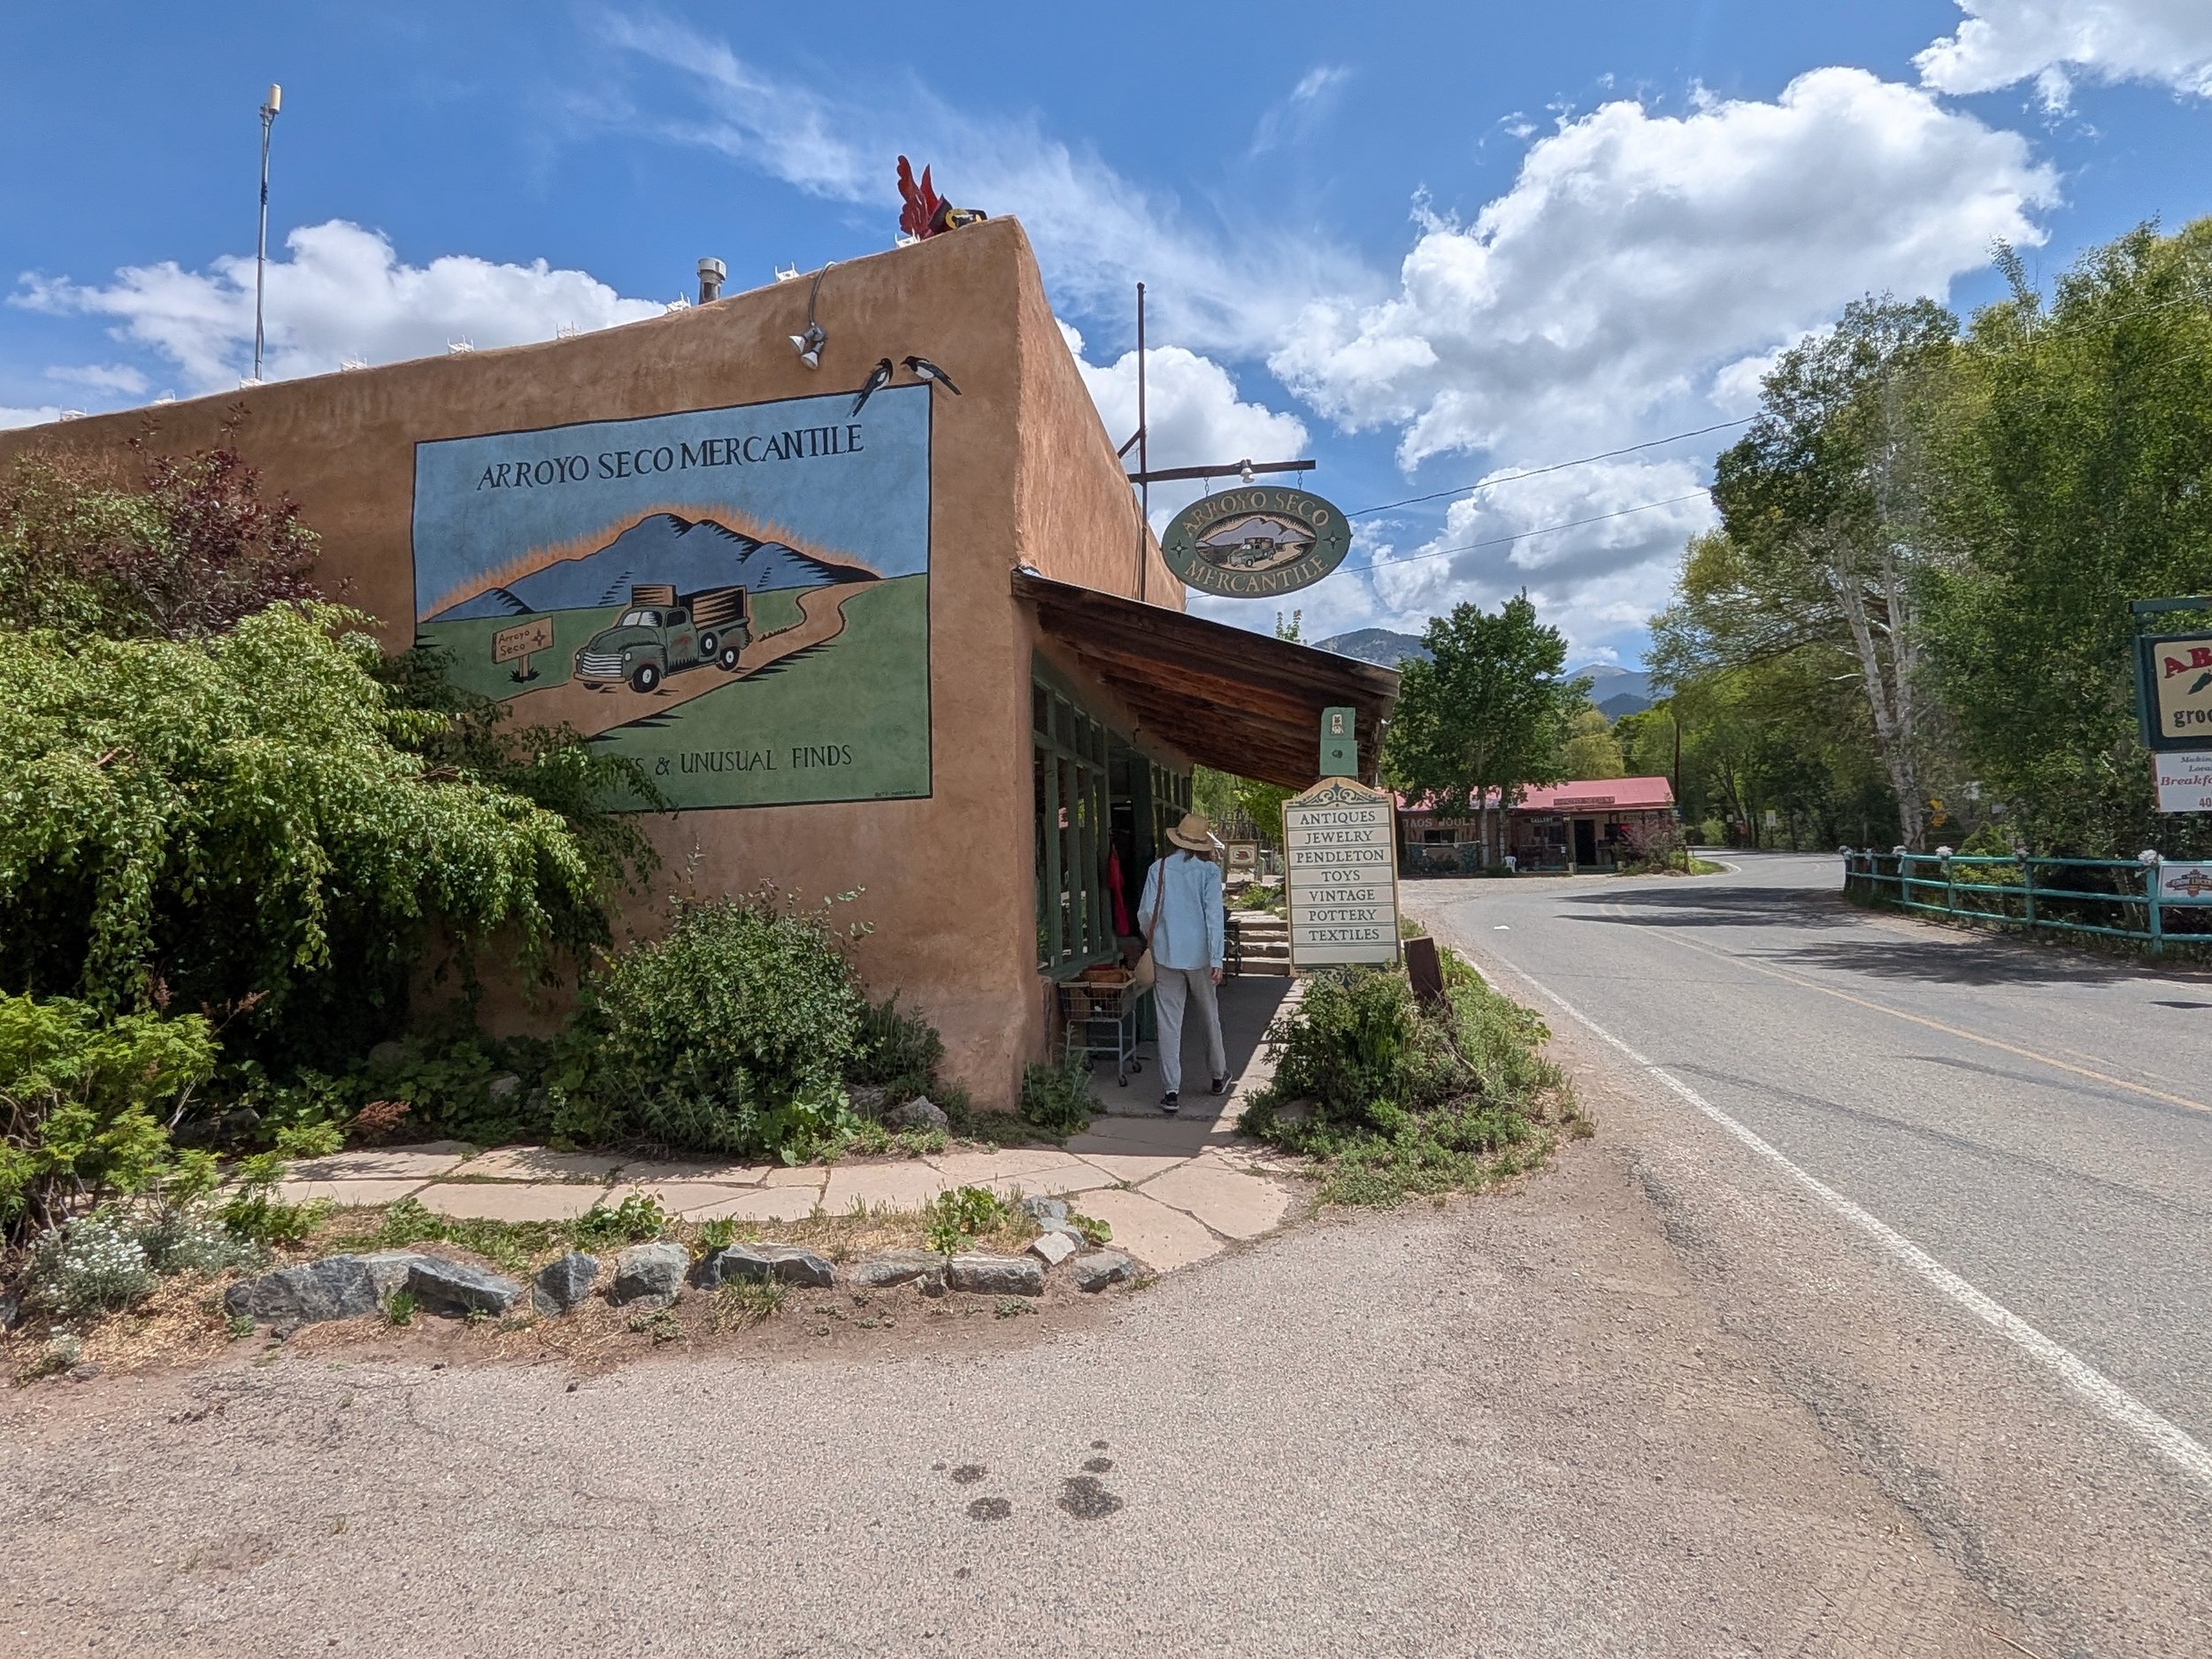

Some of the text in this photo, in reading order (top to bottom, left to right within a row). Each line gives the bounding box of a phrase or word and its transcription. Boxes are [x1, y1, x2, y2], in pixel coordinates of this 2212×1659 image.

[477, 425, 864, 491] ARROYO SECO MERCANTILE
[1182, 491, 1330, 538] ARROYO SECO
[1184, 554, 1329, 593] MERCANTILE
[498, 630, 530, 645] Arroyo
[499, 643, 526, 656] Seco
[655, 757, 671, 776] &
[680, 749, 777, 774] UNUSUAL
[792, 744, 853, 769] FINDS
[1300, 811, 1376, 825] ANTIQUES
[1304, 830, 1373, 844] JEWELRY
[1296, 849, 1385, 864] PENDLETON
[1321, 870, 1361, 882] TOYS
[1309, 889, 1375, 902] VINTAGE
[1309, 909, 1378, 922] POTTERY
[1309, 928, 1380, 941] TEXTILES
